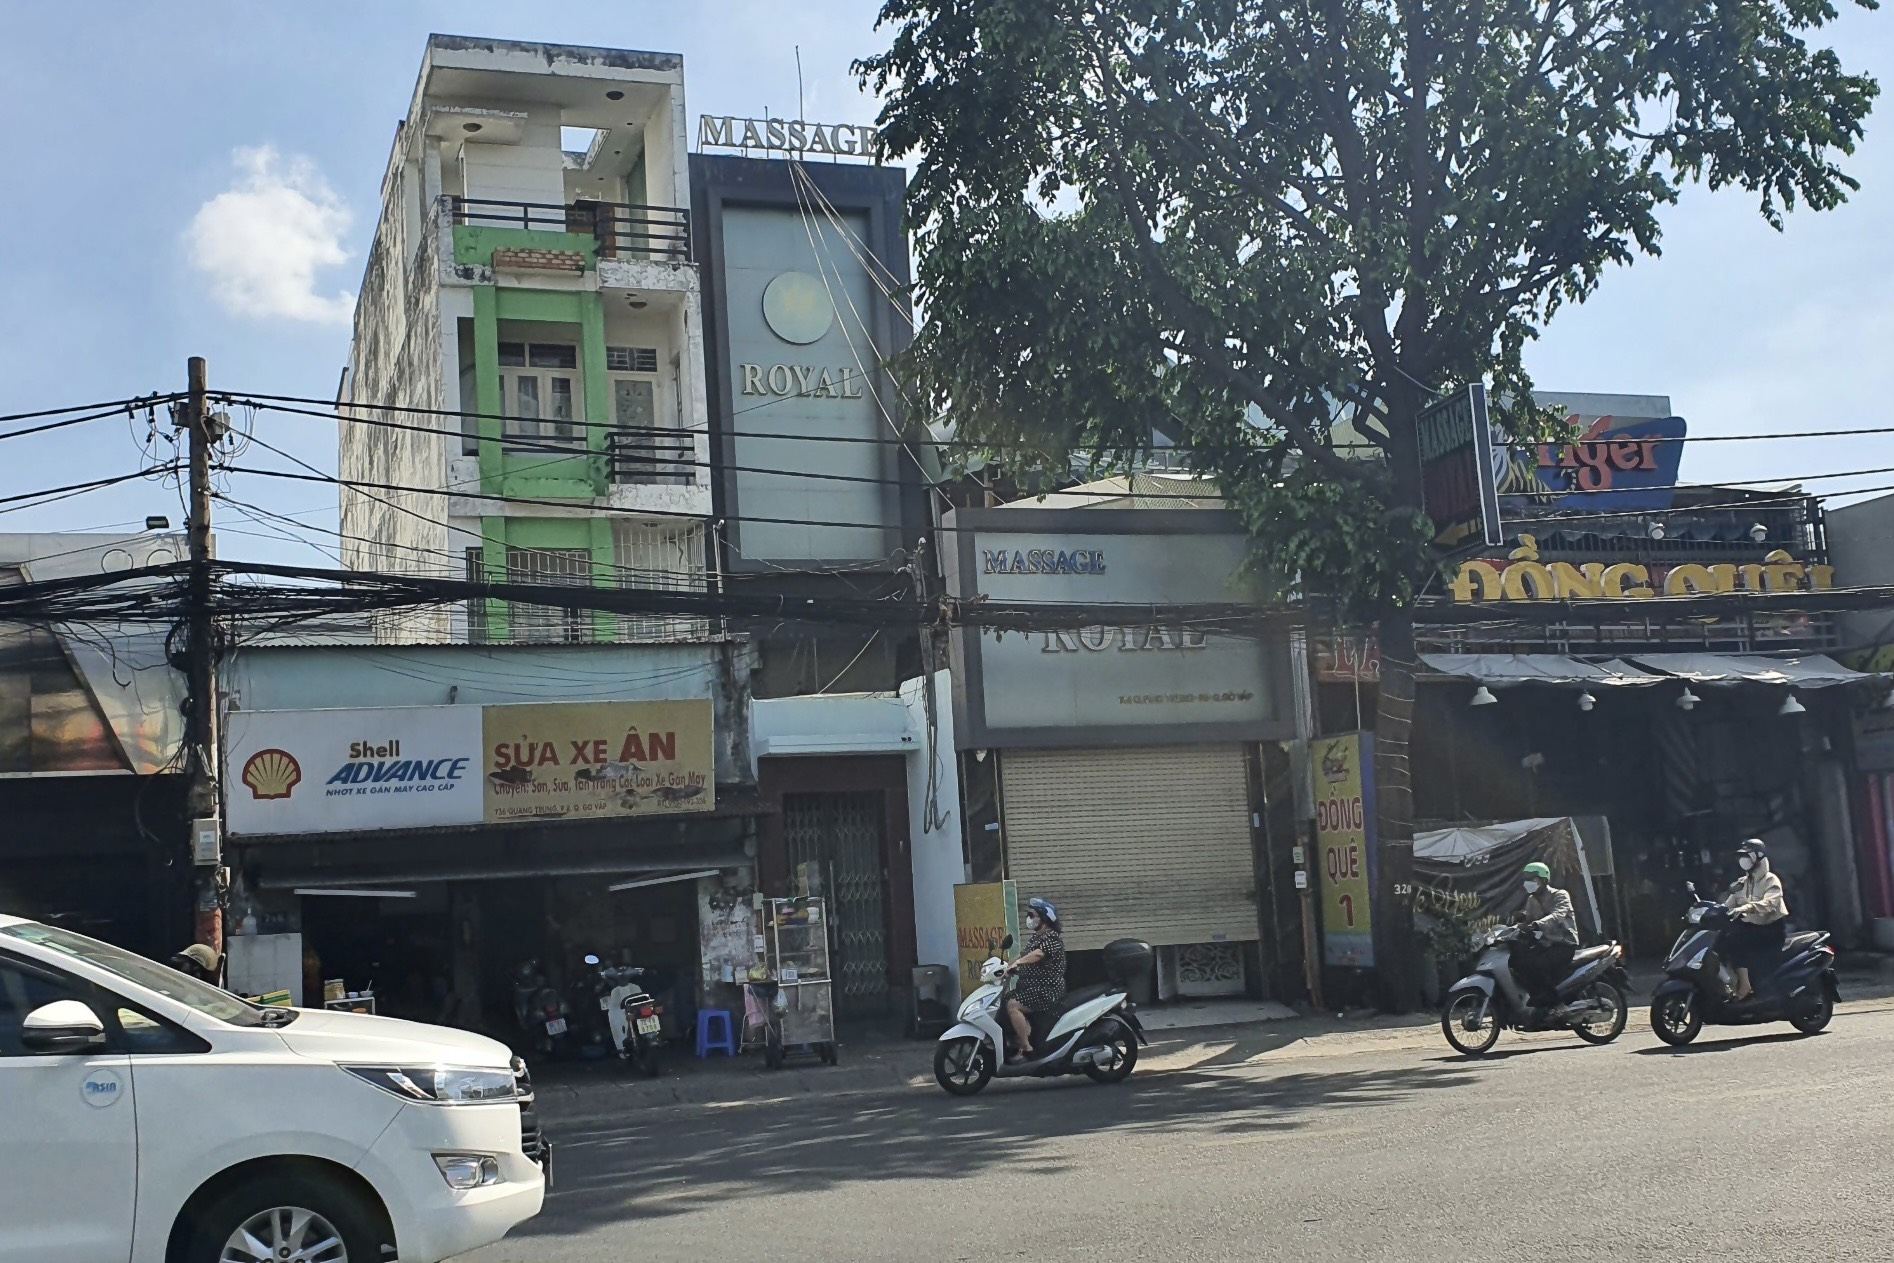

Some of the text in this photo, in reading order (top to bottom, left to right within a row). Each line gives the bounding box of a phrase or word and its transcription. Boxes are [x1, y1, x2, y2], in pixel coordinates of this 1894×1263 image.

[702, 114, 877, 157] MASSAGE
[740, 363, 862, 399] ROYAL
[983, 550, 1106, 575] MASSAGE
[349, 739, 400, 759] Shell
[494, 725, 675, 770] SỬA XE ÂN
[325, 757, 470, 785] ADVANCE
[656, 772, 666, 787] Xe
[356, 786, 367, 795] XE
[416, 784, 434, 792] CAO
[1327, 837, 1360, 886] QUÊ
[1338, 893, 1354, 927] 1
[959, 926, 1003, 949] MASSAGE
